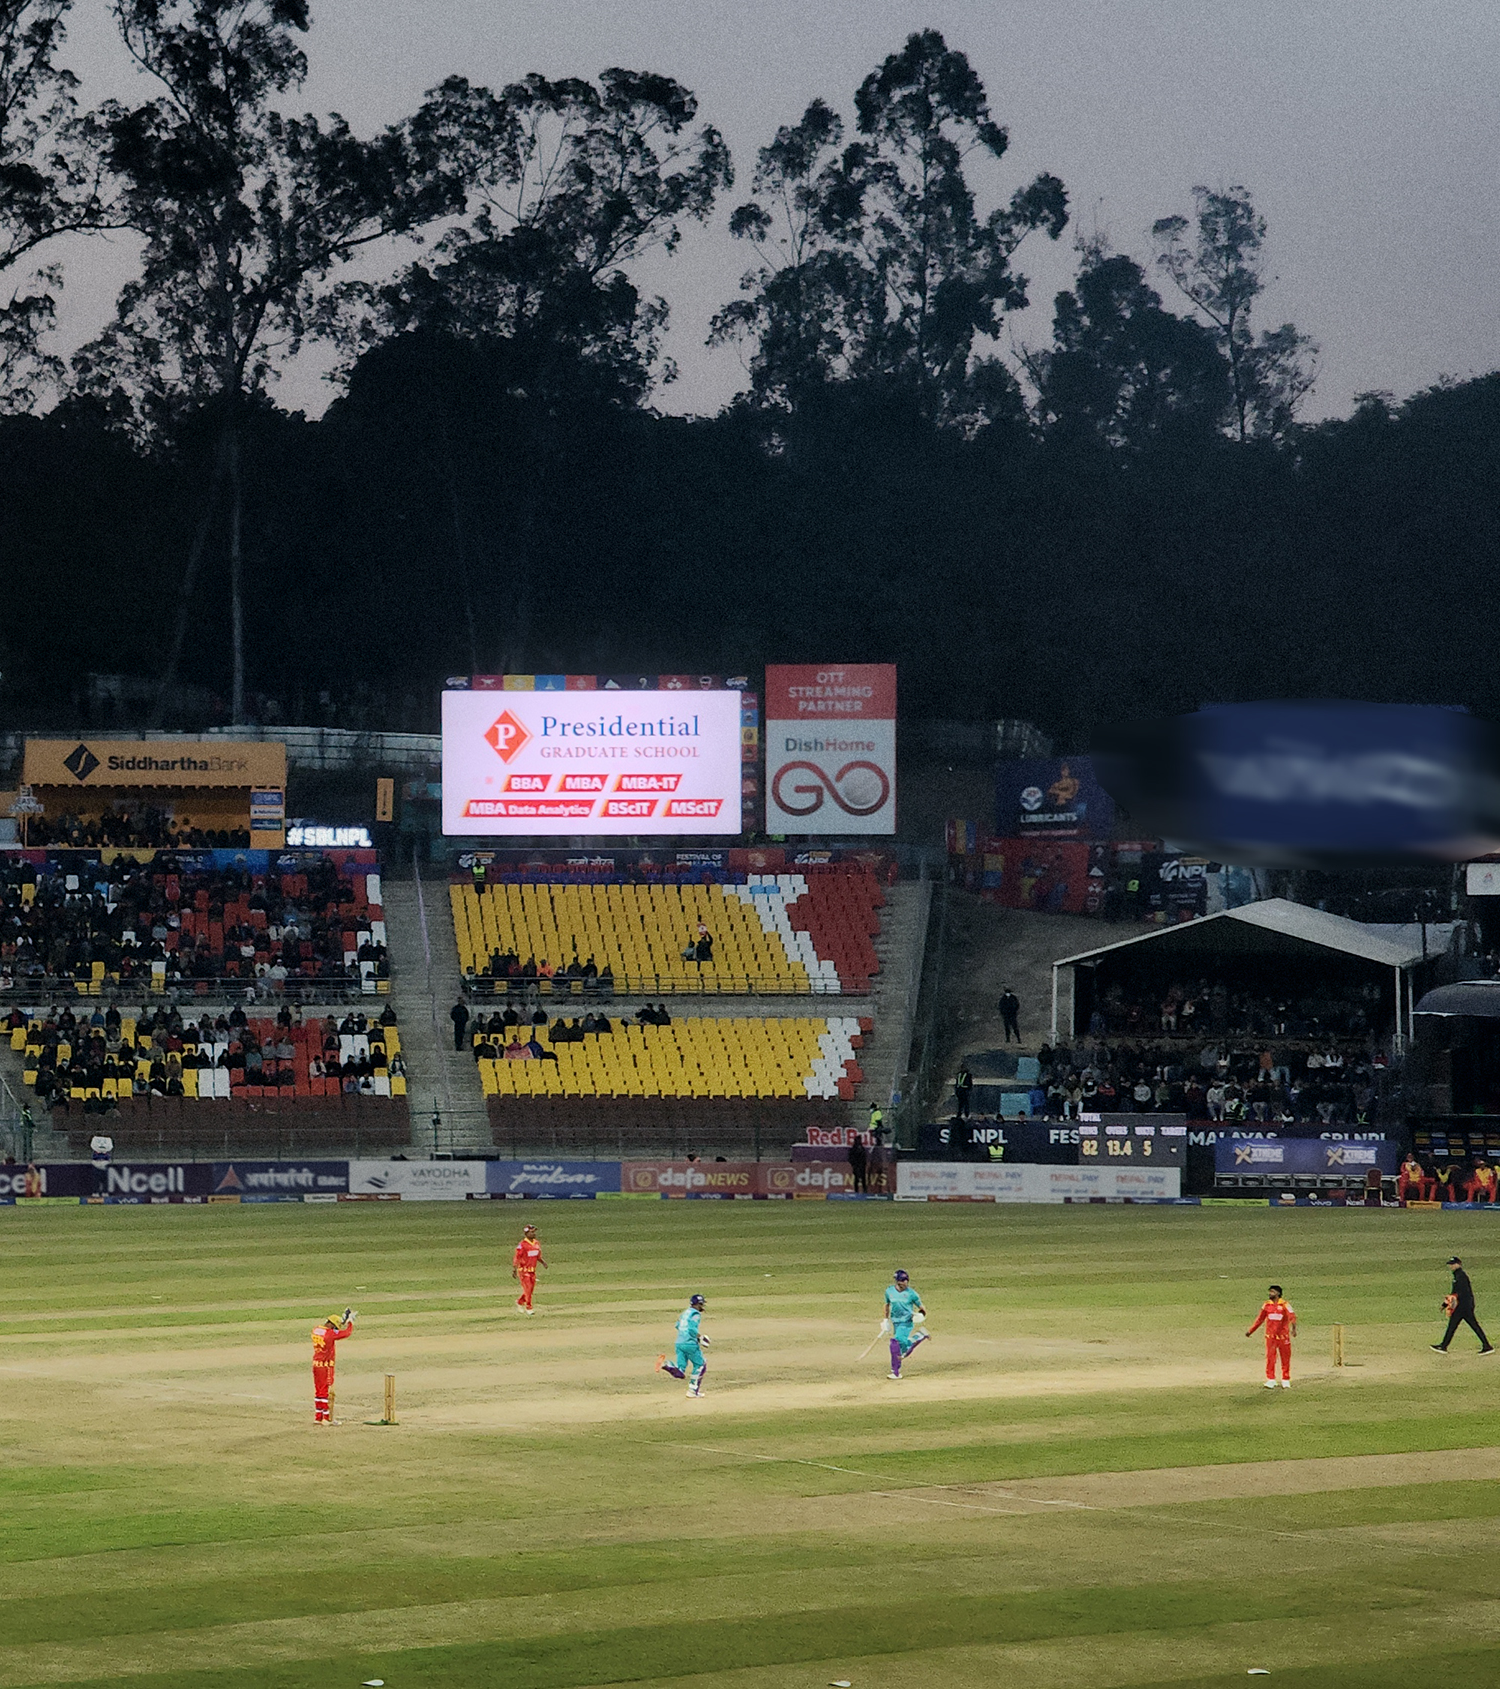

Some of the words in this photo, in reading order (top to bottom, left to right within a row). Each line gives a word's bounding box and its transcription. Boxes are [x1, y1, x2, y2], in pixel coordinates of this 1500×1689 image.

[816, 672, 845, 684] OTT
[788, 686, 873, 698] STREAMING
[798, 700, 863, 712] PARTNER
[540, 715, 700, 737] Presidential
[494, 723, 516, 750] P
[785, 738, 875, 751] DishHome
[540, 746, 628, 758] GRADUATE
[635, 746, 700, 758] SCHOOL
[511, 776, 543, 790] BBA
[565, 776, 602, 790] MBA
[622, 776, 678, 790] MBA-IT
[469, 802, 506, 815] MBA
[508, 804, 536, 815] Data
[538, 804, 590, 817] Analytics
[608, 802, 649, 815] BScIT
[670, 802, 718, 815] MScIT
[1020, 812, 1077, 823] LUBRICANTS
[807, 1127, 841, 1146] Red
[1082, 1140, 1098, 1156] 82
[1106, 1140, 1132, 1156] 13.4
[1143, 1140, 1152, 1156] 5
[411, 1169, 469, 1178] VAYODHA
[796, 1168, 887, 1188] dafaNWS
[107, 1167, 184, 1195] Ncell
